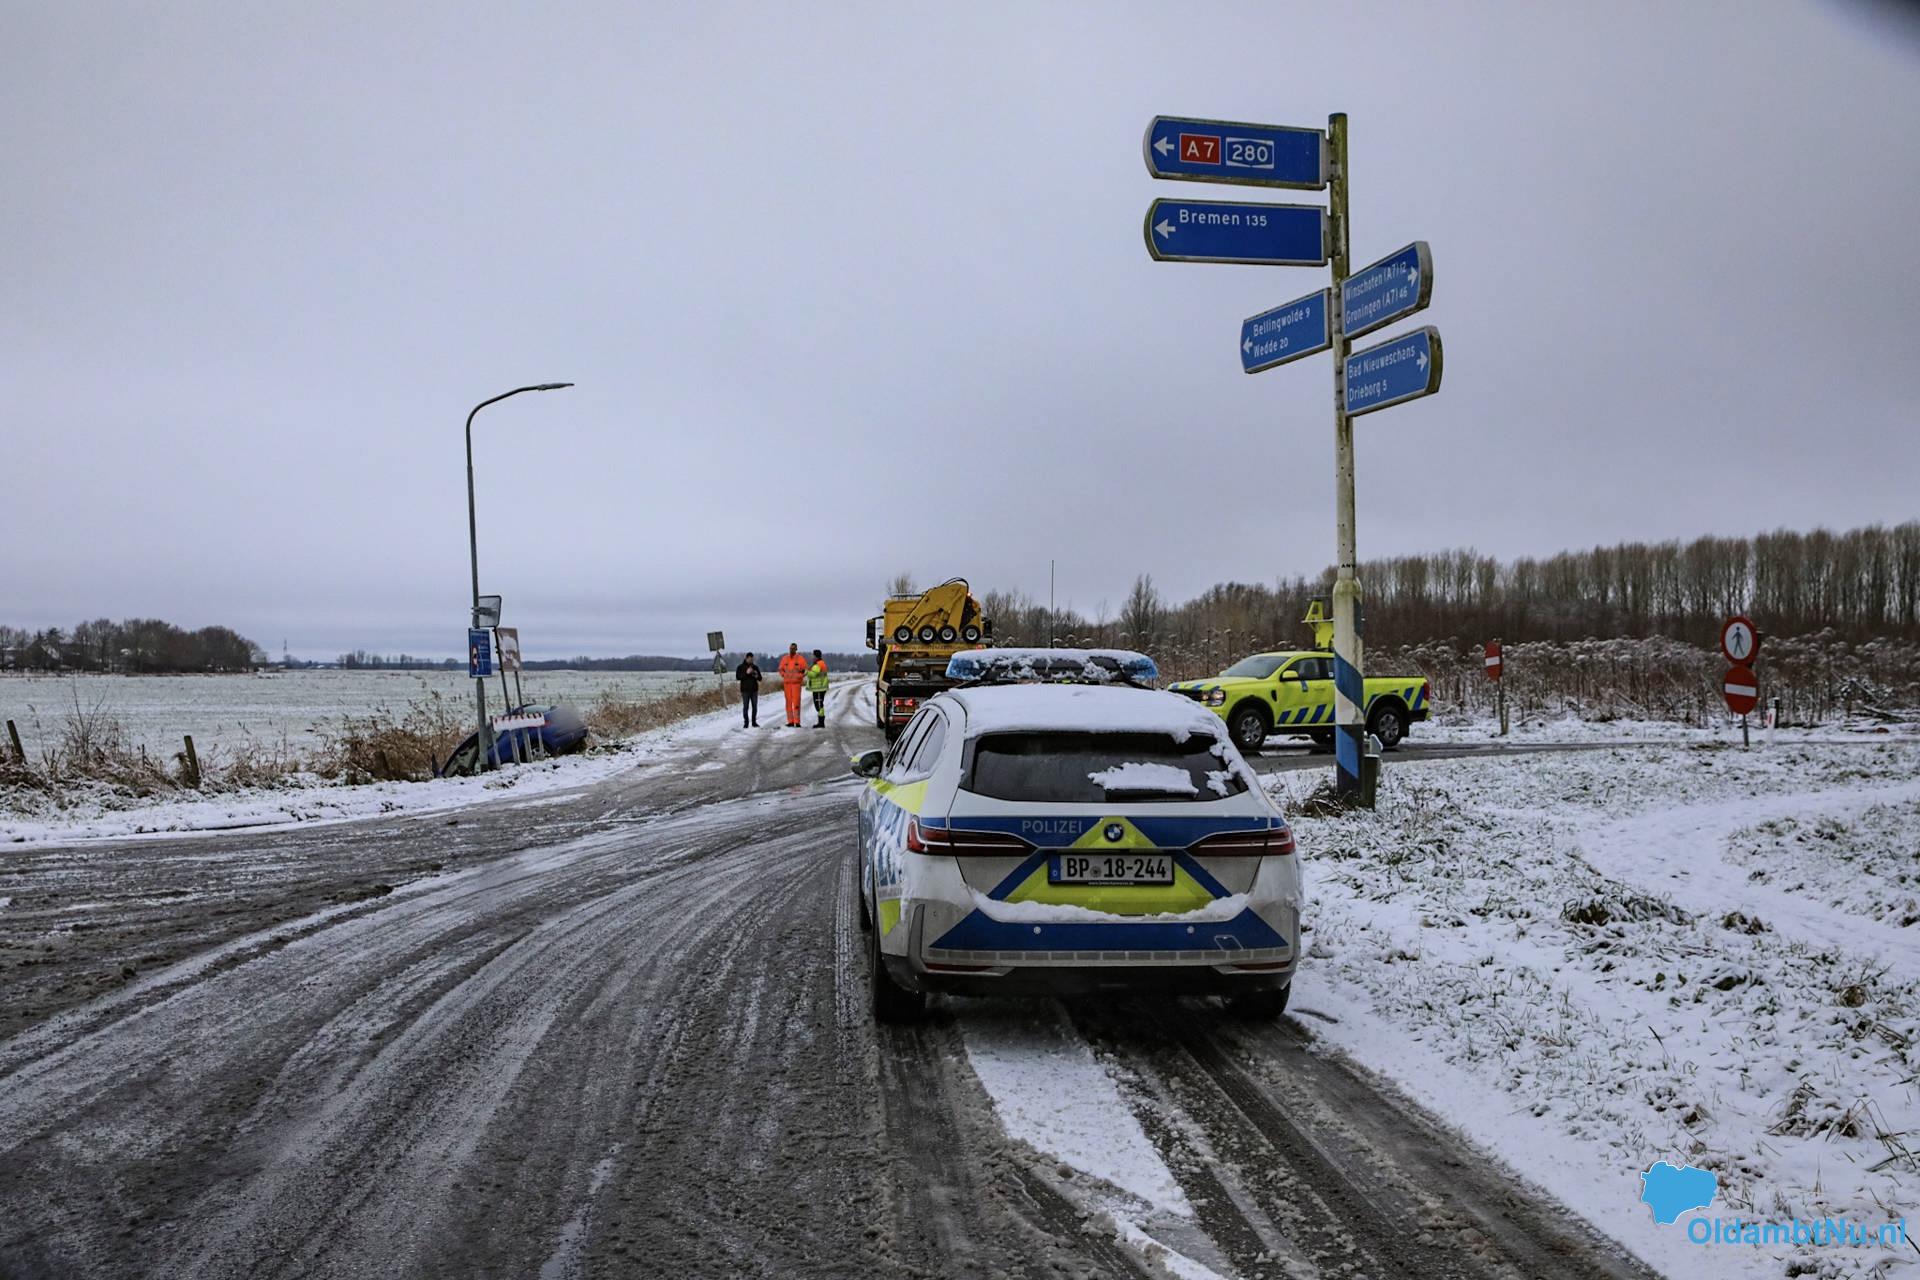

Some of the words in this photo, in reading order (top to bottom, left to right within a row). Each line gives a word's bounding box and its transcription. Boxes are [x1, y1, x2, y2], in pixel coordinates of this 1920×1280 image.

[1186, 142, 1215, 158] A7
[1232, 144, 1268, 162] 280
[1179, 209, 1240, 225] Bremen
[1246, 215, 1267, 227] 135
[1346, 273, 1383, 301] Winschoten
[1346, 299, 1381, 325] Groningen
[1399, 286, 1408, 299] 46
[1253, 309, 1303, 337] Bellingwolde
[1305, 307, 1311, 318] 9
[1254, 339, 1278, 358] Wedde
[1279, 336, 1289, 349] 20
[1348, 363, 1361, 379] Bad
[1363, 345, 1416, 374] Nieuweschans
[1348, 381, 1381, 402] Drieborg
[1382, 379, 1387, 392] 5
[1021, 820, 1082, 834] POLIZEI
[1066, 857, 1090, 878] BP
[1103, 857, 1167, 878] 18-244
